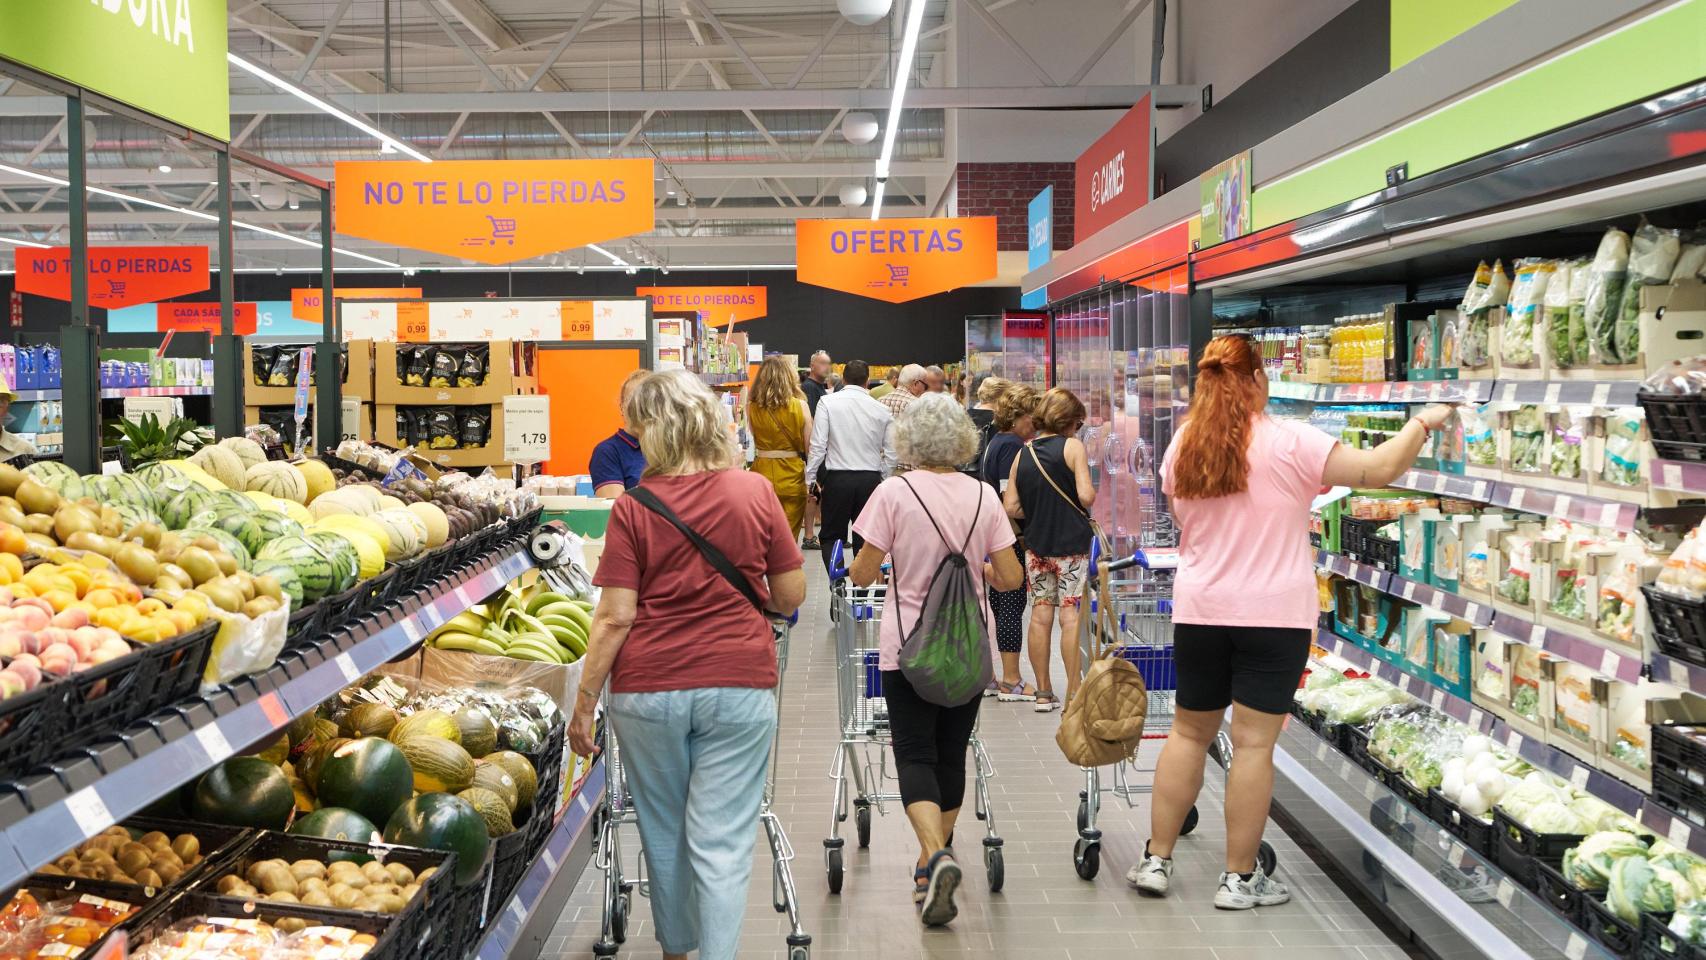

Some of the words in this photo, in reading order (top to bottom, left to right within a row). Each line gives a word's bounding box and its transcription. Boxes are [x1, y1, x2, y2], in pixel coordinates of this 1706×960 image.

[1100, 150, 1125, 205] CARNES
[364, 181, 404, 205] NO
[413, 181, 448, 205] TE
[457, 181, 493, 204] LO
[503, 180, 626, 204] PIERDAS
[830, 228, 963, 254] OFERTAS
[32, 259, 57, 273] NO
[62, 259, 72, 273] T
[89, 259, 112, 273] LO
[116, 258, 193, 273] PIERDAS
[303, 297, 320, 307] NO
[669, 295, 682, 305] TE
[686, 295, 700, 305] LO
[704, 294, 756, 305] PIERDAS
[174, 308, 199, 317] CADA
[342, 433, 357, 441] 25
[521, 433, 547, 445] 1,79
